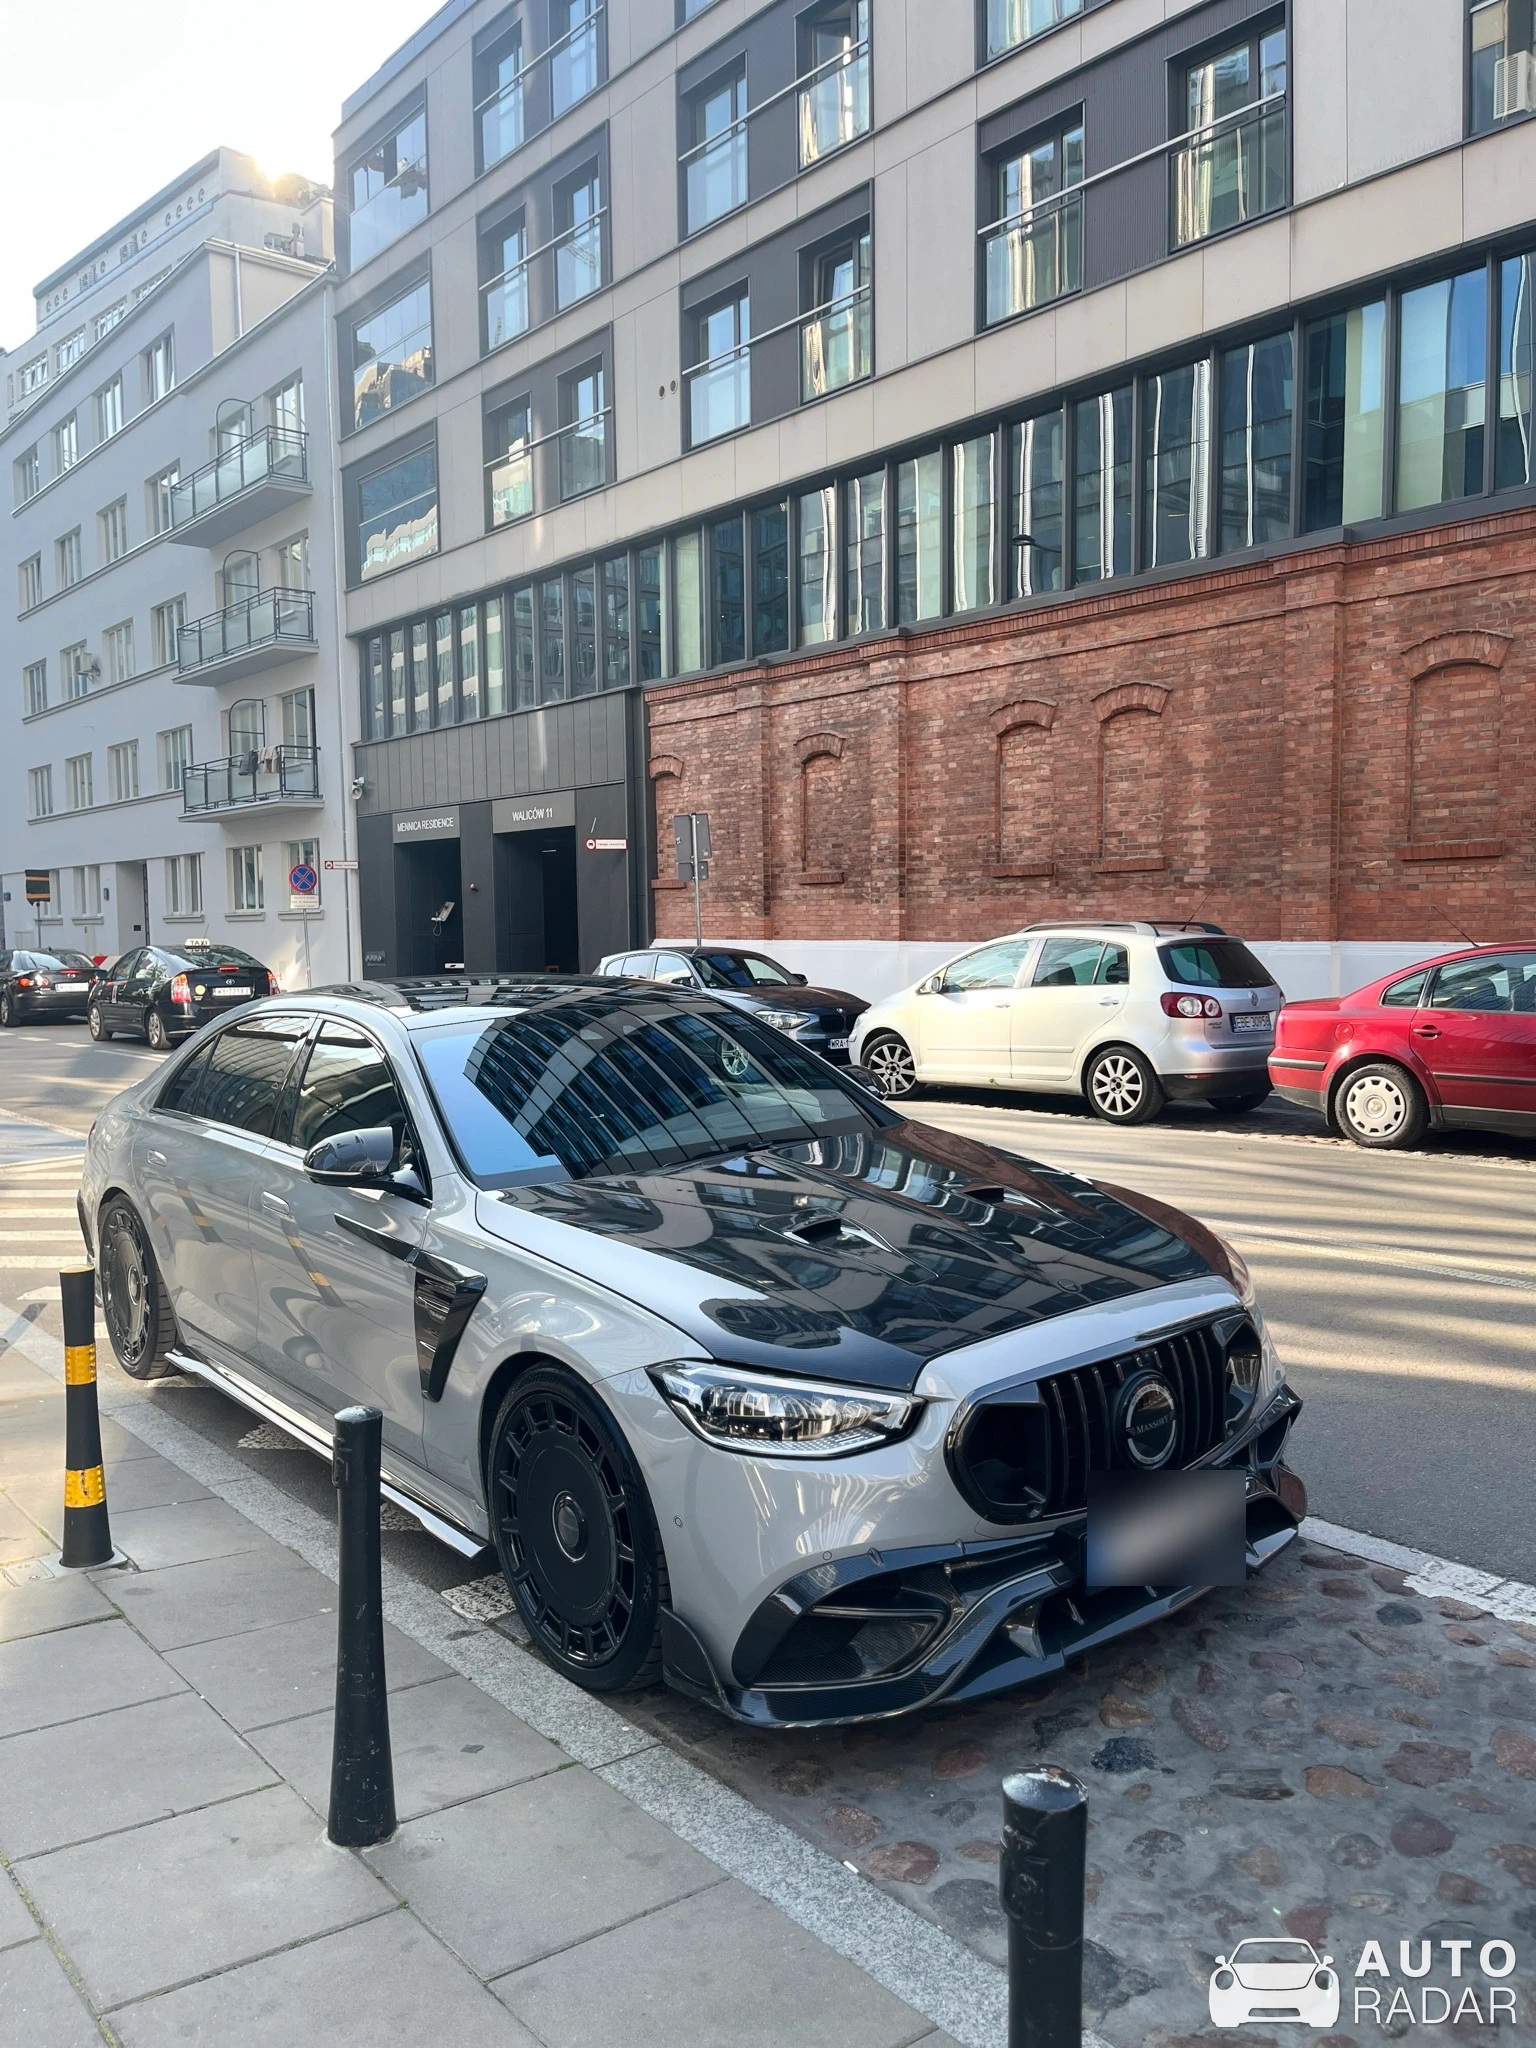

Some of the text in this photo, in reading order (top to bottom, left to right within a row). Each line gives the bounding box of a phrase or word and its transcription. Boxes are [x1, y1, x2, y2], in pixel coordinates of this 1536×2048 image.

[512, 807, 553, 821] WALICÓW 11
[397, 817, 454, 832] MENNICA RESIDENCE
[1136, 1414, 1169, 1435] MANSORY
